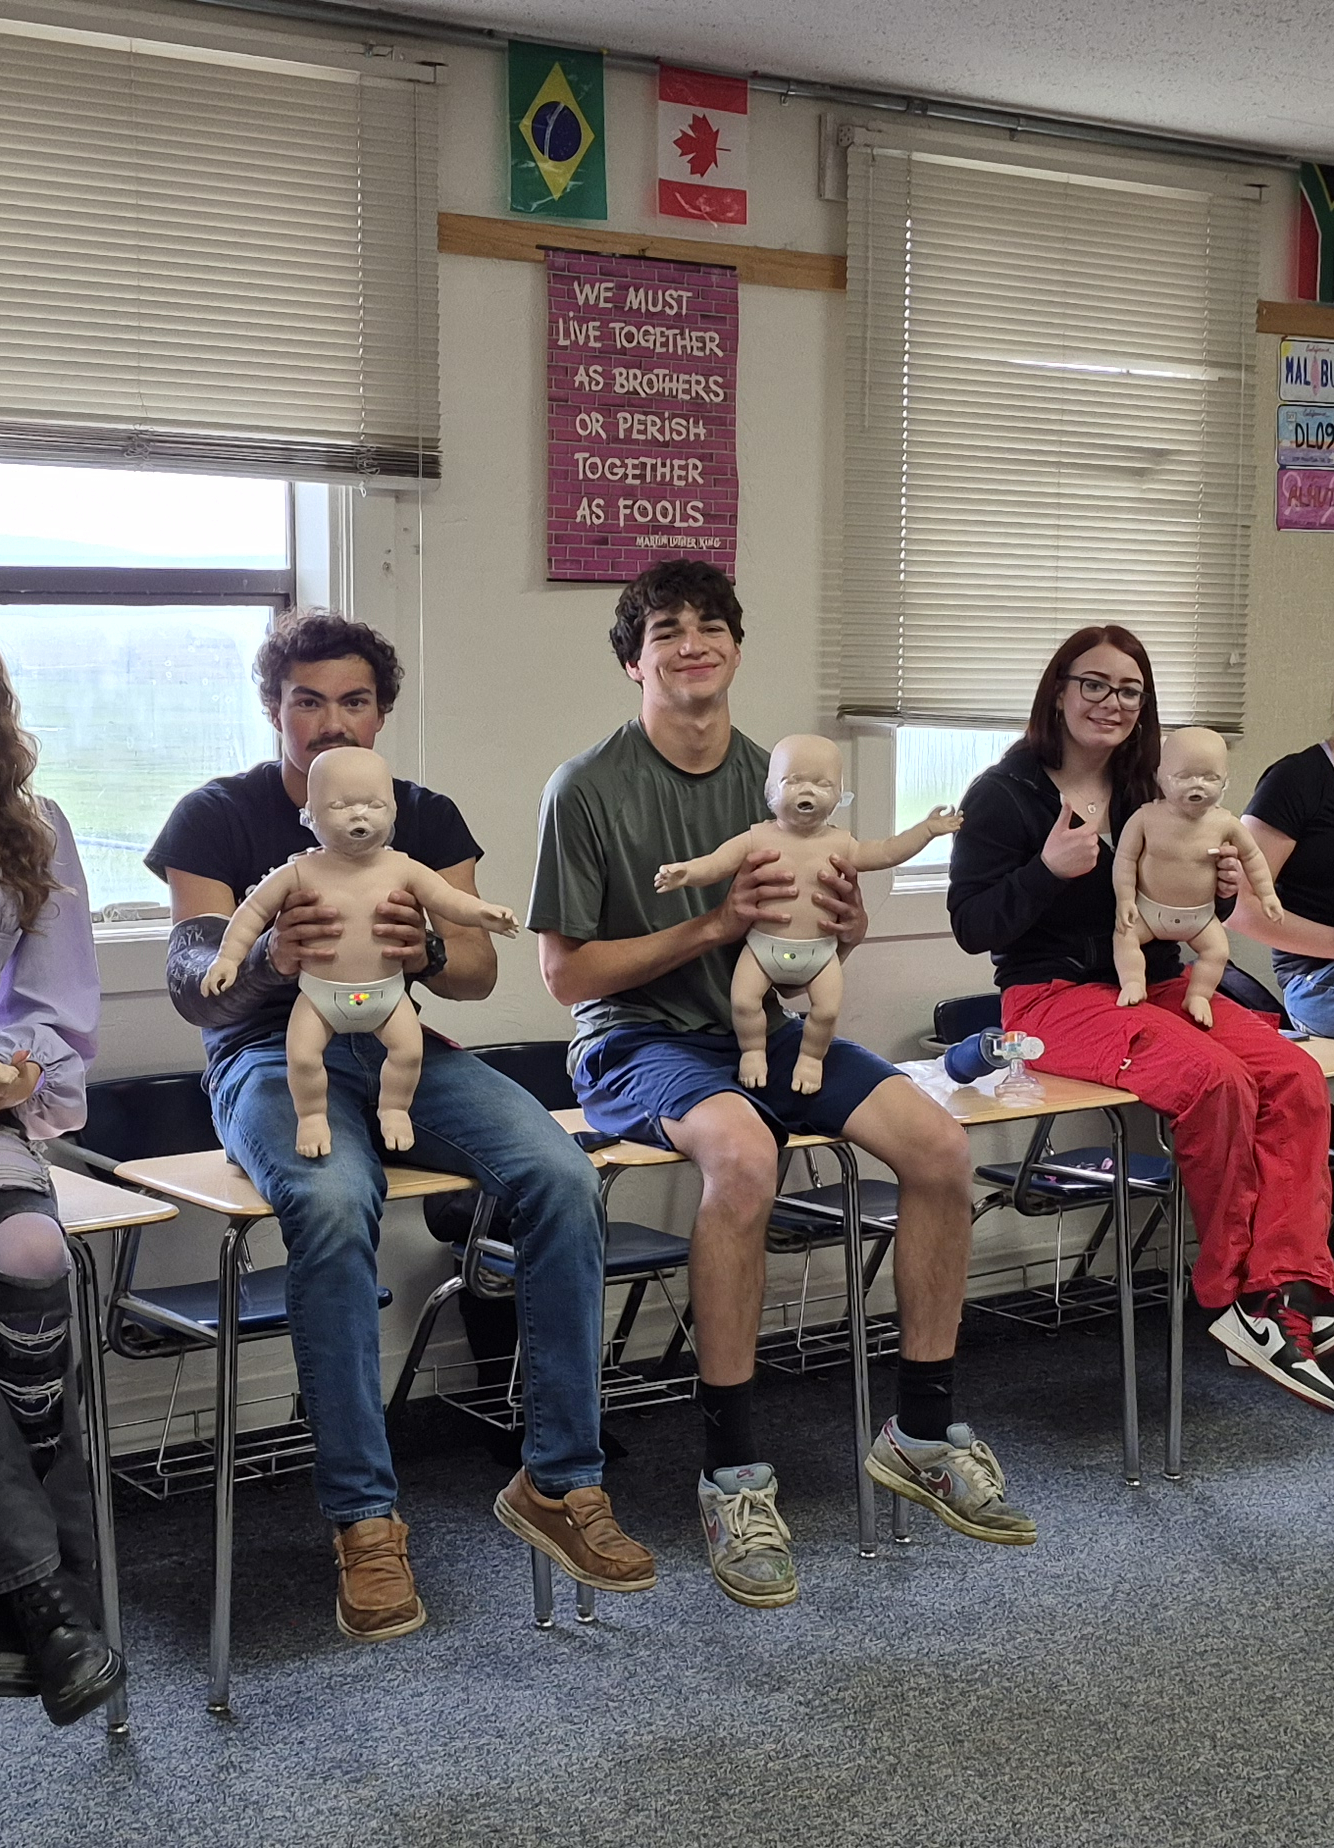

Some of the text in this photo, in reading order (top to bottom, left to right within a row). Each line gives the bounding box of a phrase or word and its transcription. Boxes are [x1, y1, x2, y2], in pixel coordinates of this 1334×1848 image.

[573, 280, 693, 317] WE MUST
[609, 322, 724, 358] TOGETHER
[574, 364, 725, 403] AS BROTHERS
[575, 411, 607, 440] OR
[1295, 422, 1334, 450] DL09
[574, 452, 704, 486] TOGETHER
[575, 496, 705, 528] AS FOOLS
